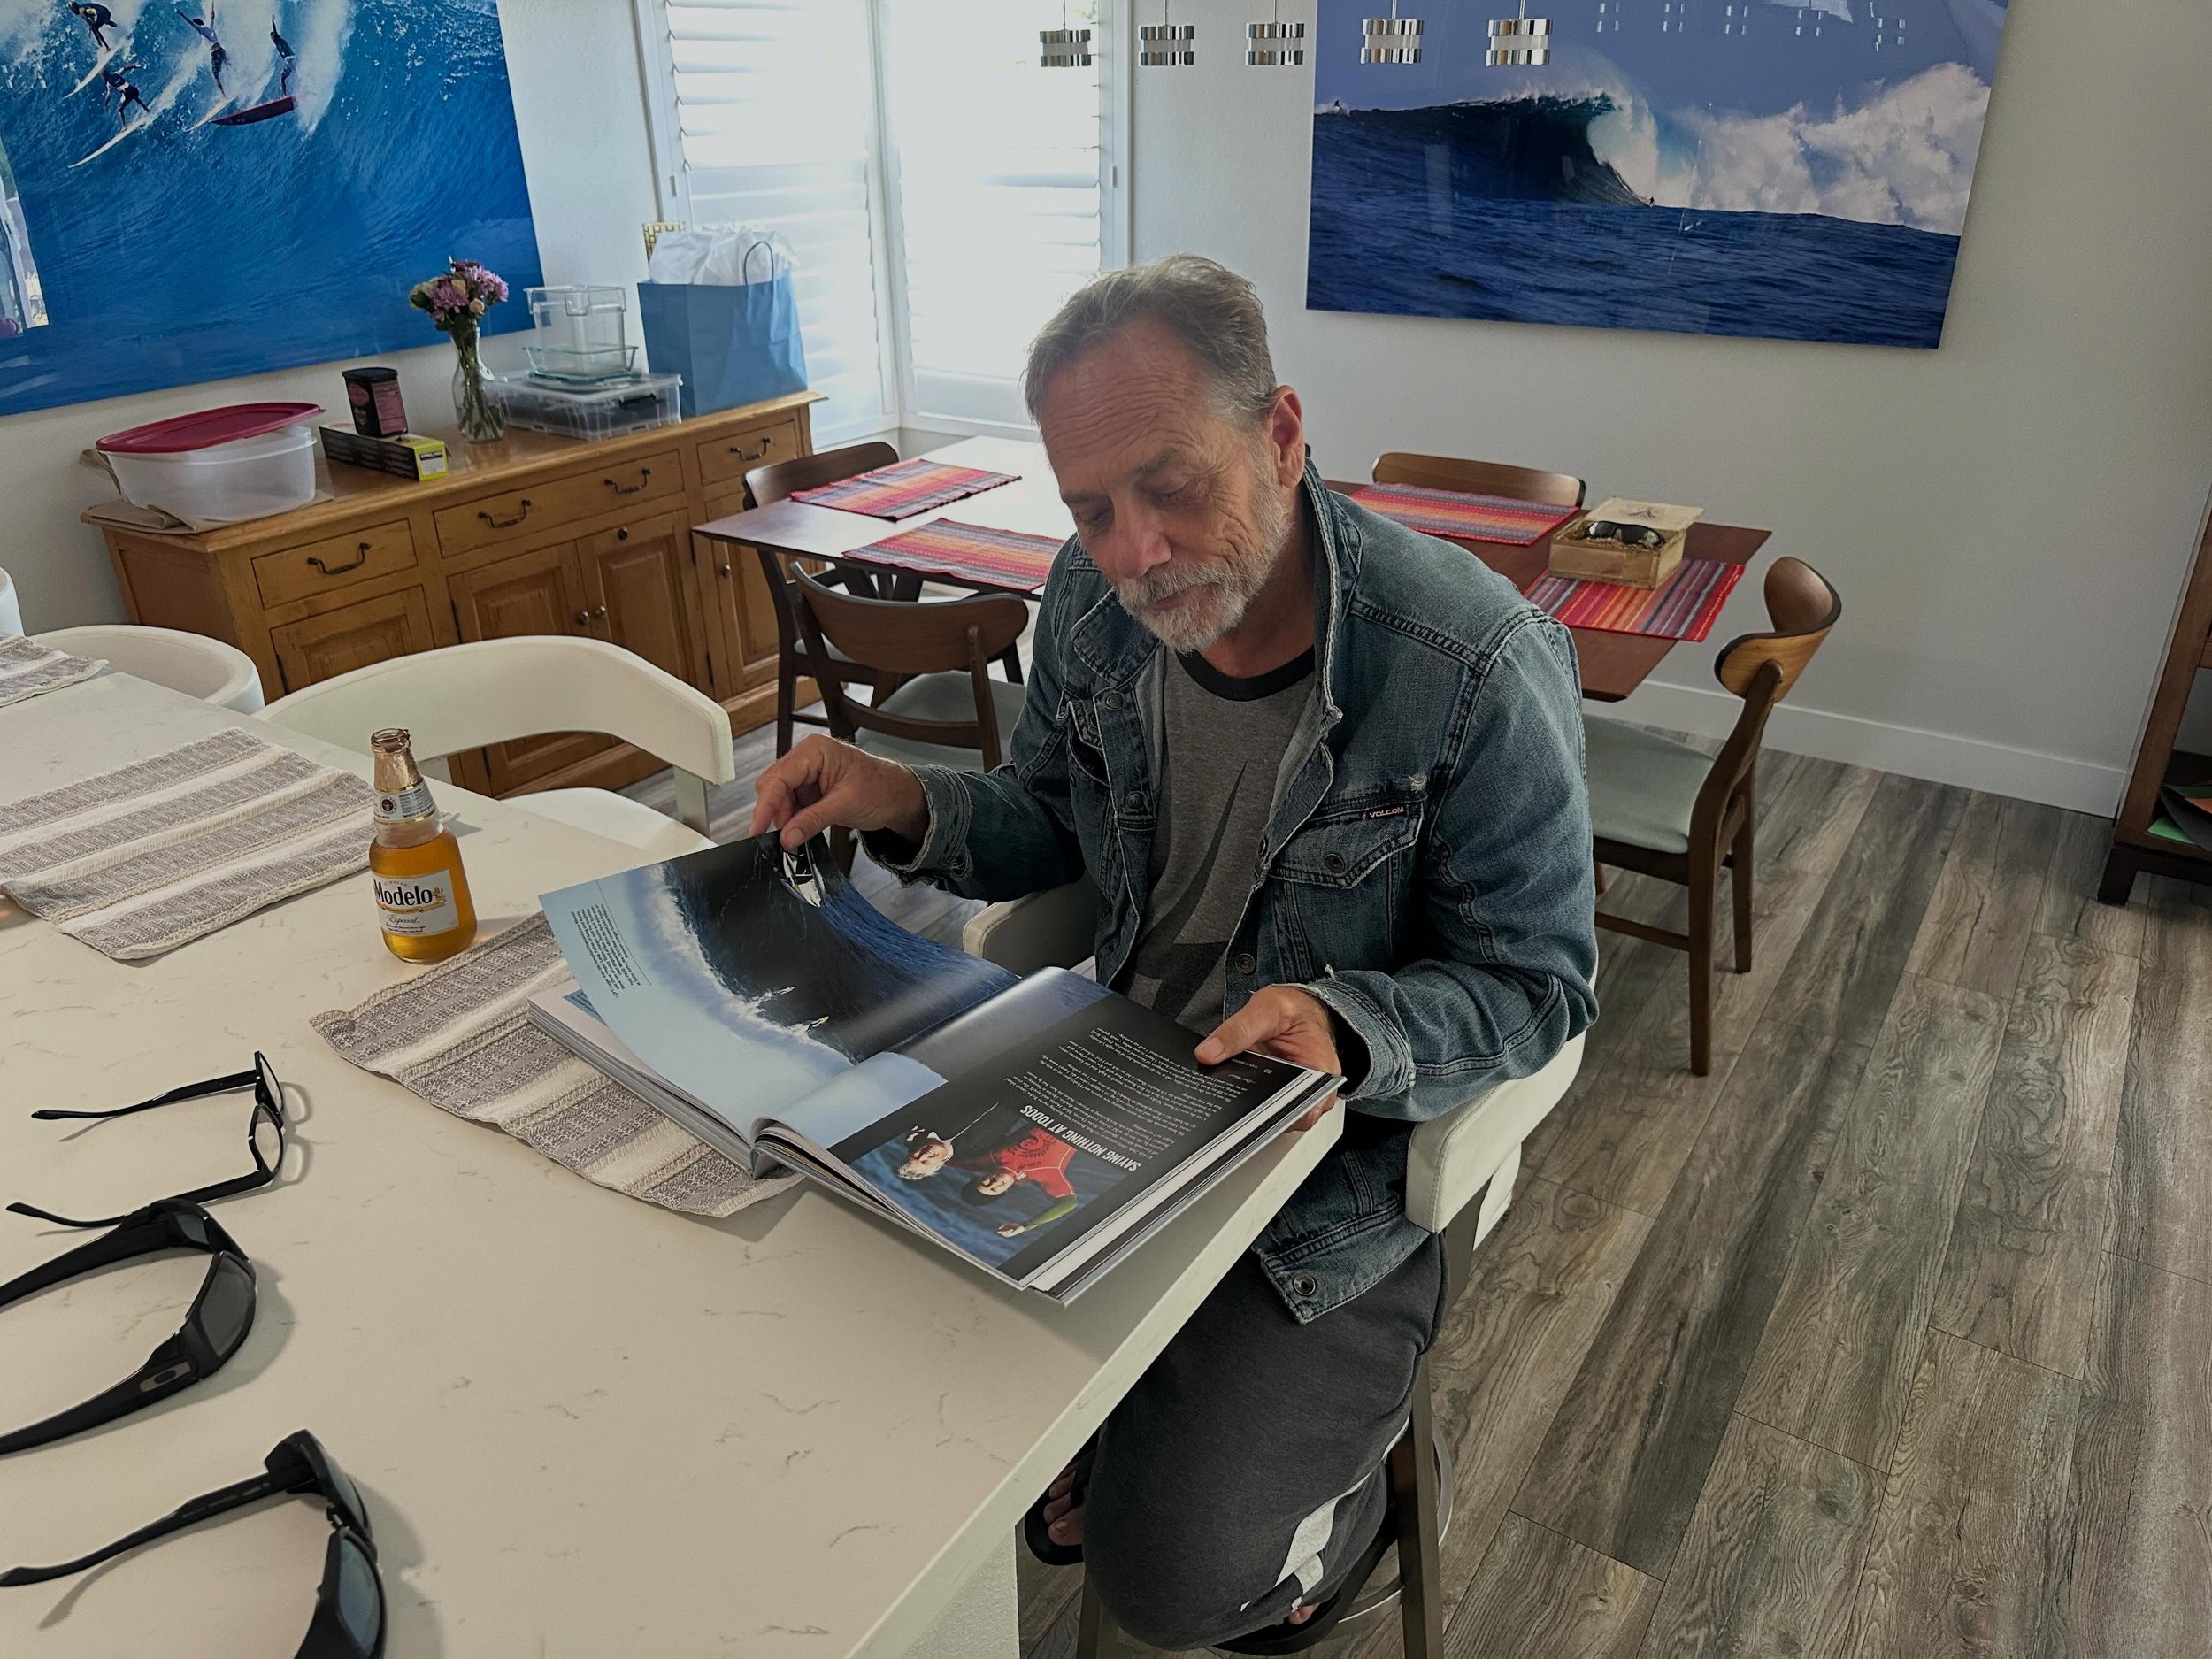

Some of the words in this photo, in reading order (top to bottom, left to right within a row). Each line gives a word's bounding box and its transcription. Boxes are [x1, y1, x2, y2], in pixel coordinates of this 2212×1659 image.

[1369, 806, 1404, 818] VOLCOM
[373, 879, 433, 906] Modelo
[1020, 1105, 1054, 1126] TODOS
[1049, 1124, 1067, 1133] AT
[1063, 1130, 1107, 1155] NOTHING
[1102, 1151, 1141, 1171] SAYING
